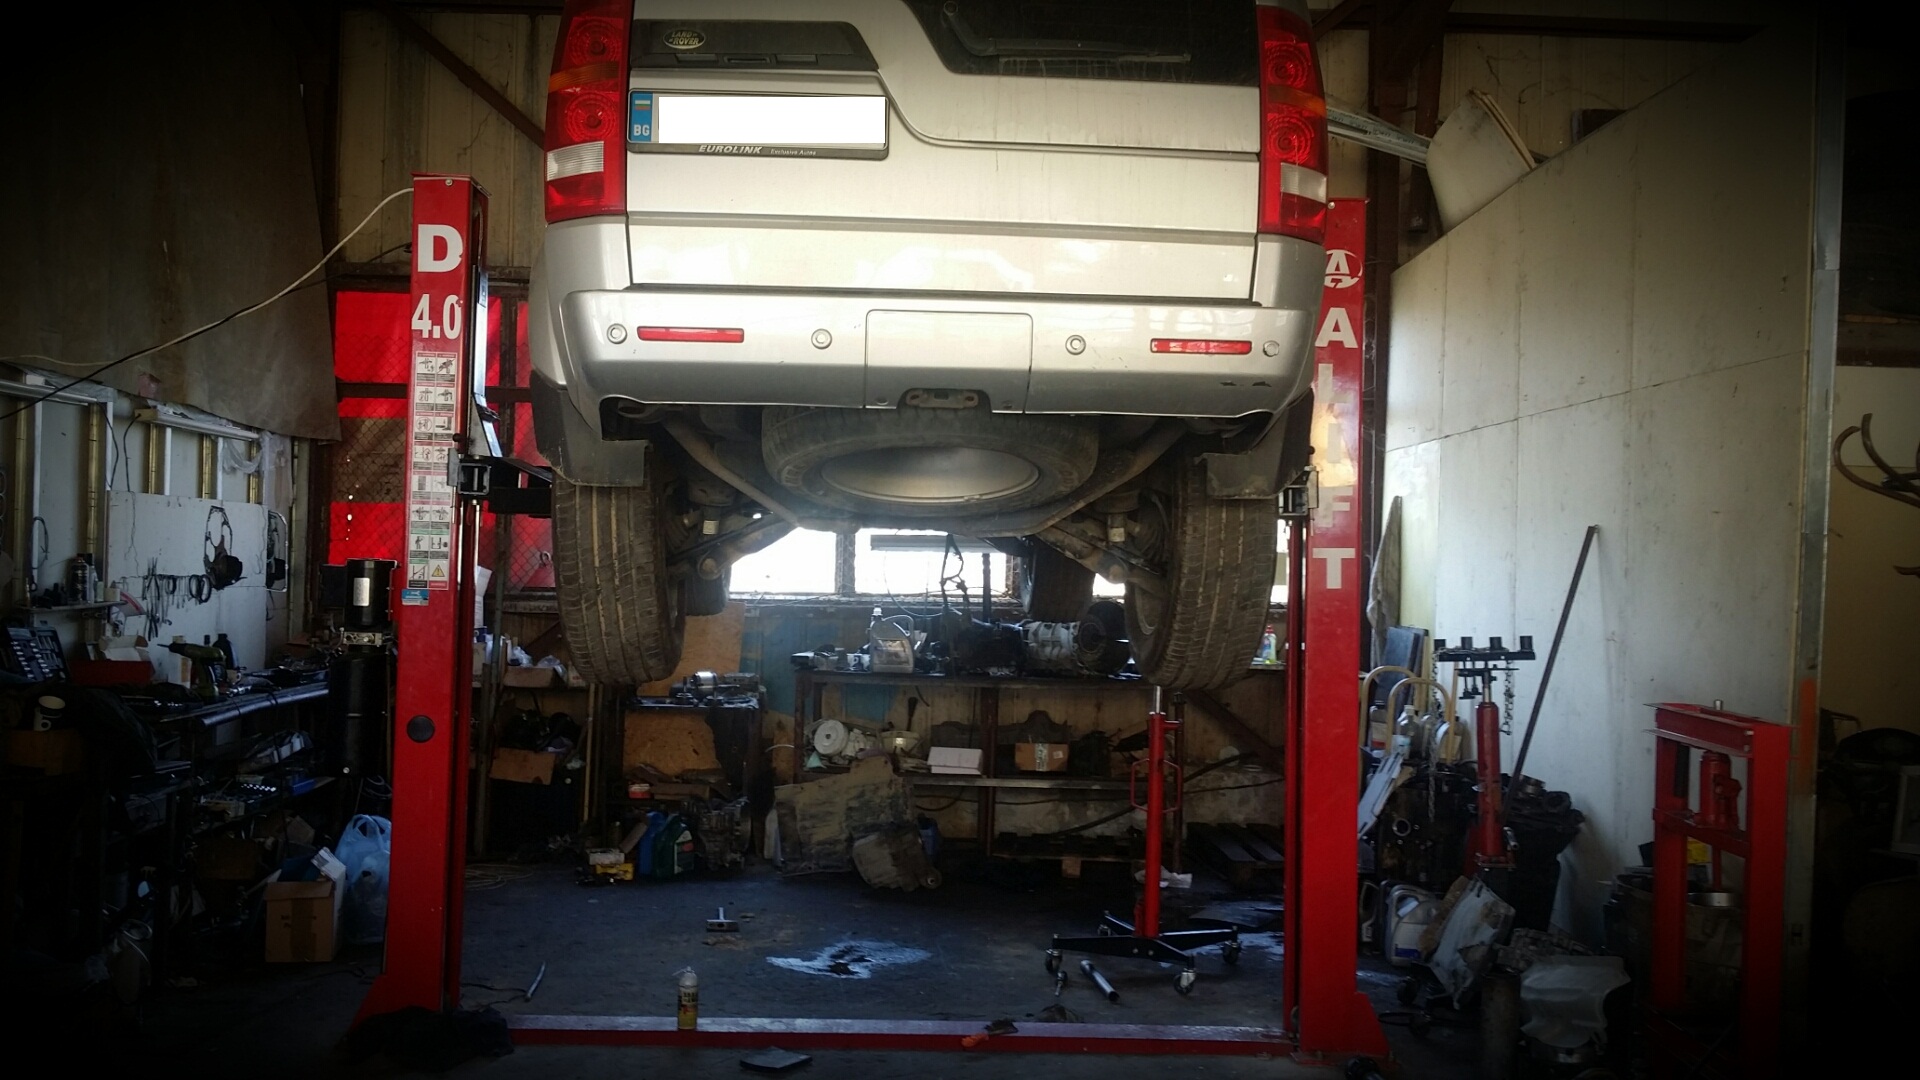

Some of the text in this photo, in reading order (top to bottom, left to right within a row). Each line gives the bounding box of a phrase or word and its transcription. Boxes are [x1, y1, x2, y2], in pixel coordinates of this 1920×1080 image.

[673, 37, 699, 45] ROVER
[633, 124, 650, 136] BG
[698, 144, 762, 154] EUROLINK
[418, 224, 463, 273] D
[411, 293, 463, 340] 4.0
